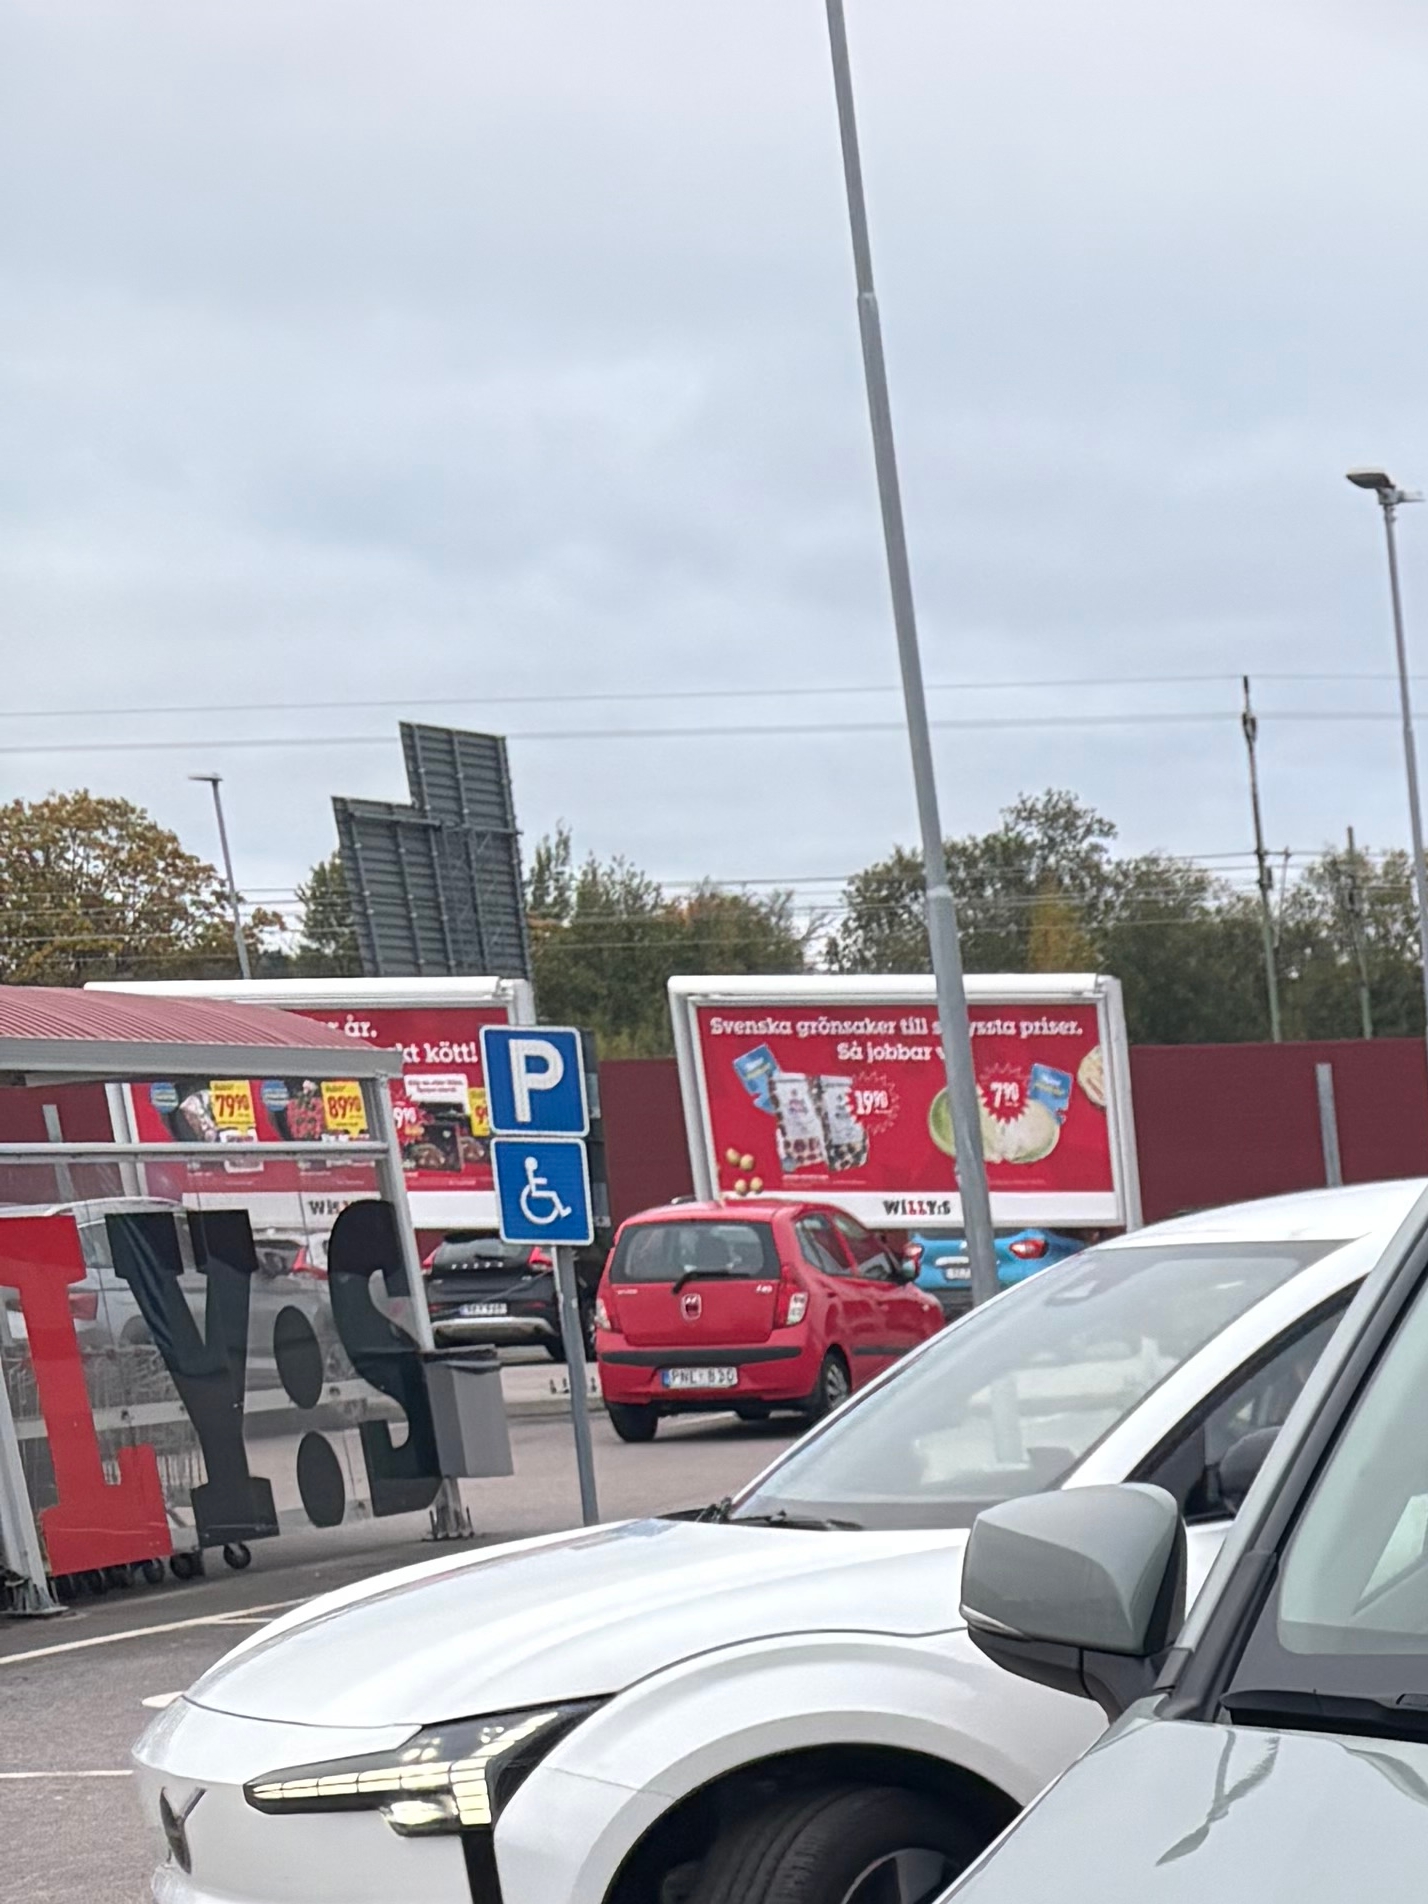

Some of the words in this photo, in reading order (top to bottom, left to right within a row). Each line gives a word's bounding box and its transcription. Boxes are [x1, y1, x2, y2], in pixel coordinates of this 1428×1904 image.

[709, 1016, 793, 1036] Svenska
[795, 1016, 897, 1039] grönsaker
[899, 1017, 928, 1036] till
[1019, 1016, 1084, 1039] priser.
[423, 1040, 479, 1063] kött!
[836, 1040, 864, 1061] Så
[866, 1041, 932, 1064] jobbar
[508, 1038, 564, 1123] P
